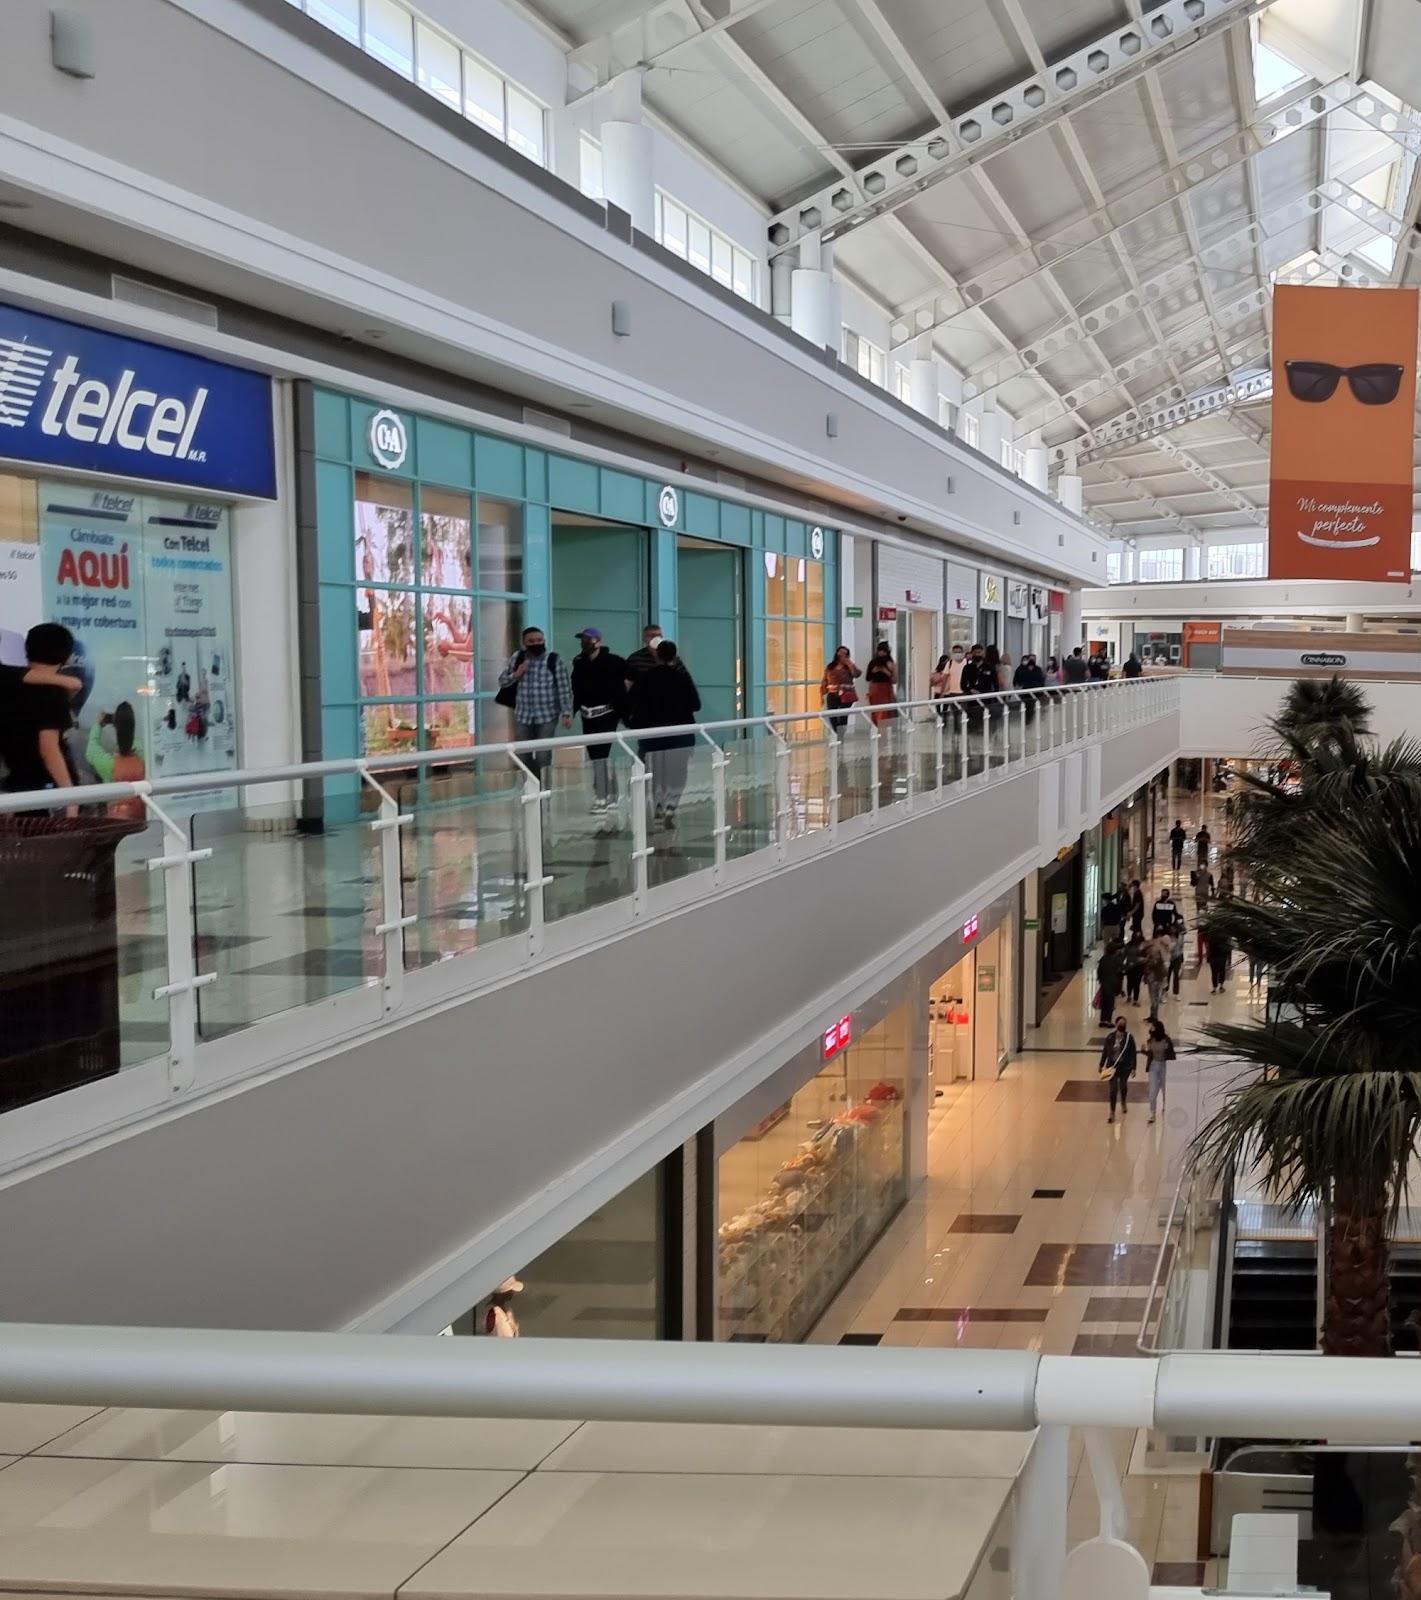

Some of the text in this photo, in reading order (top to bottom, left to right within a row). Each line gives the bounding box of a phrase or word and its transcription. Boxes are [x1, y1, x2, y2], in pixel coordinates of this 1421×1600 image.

[41, 355, 208, 460] telcel
[1311, 516, 1367, 536] perfecto
[1318, 500, 1384, 518] complemento
[57, 542, 129, 590] AQUÍ
